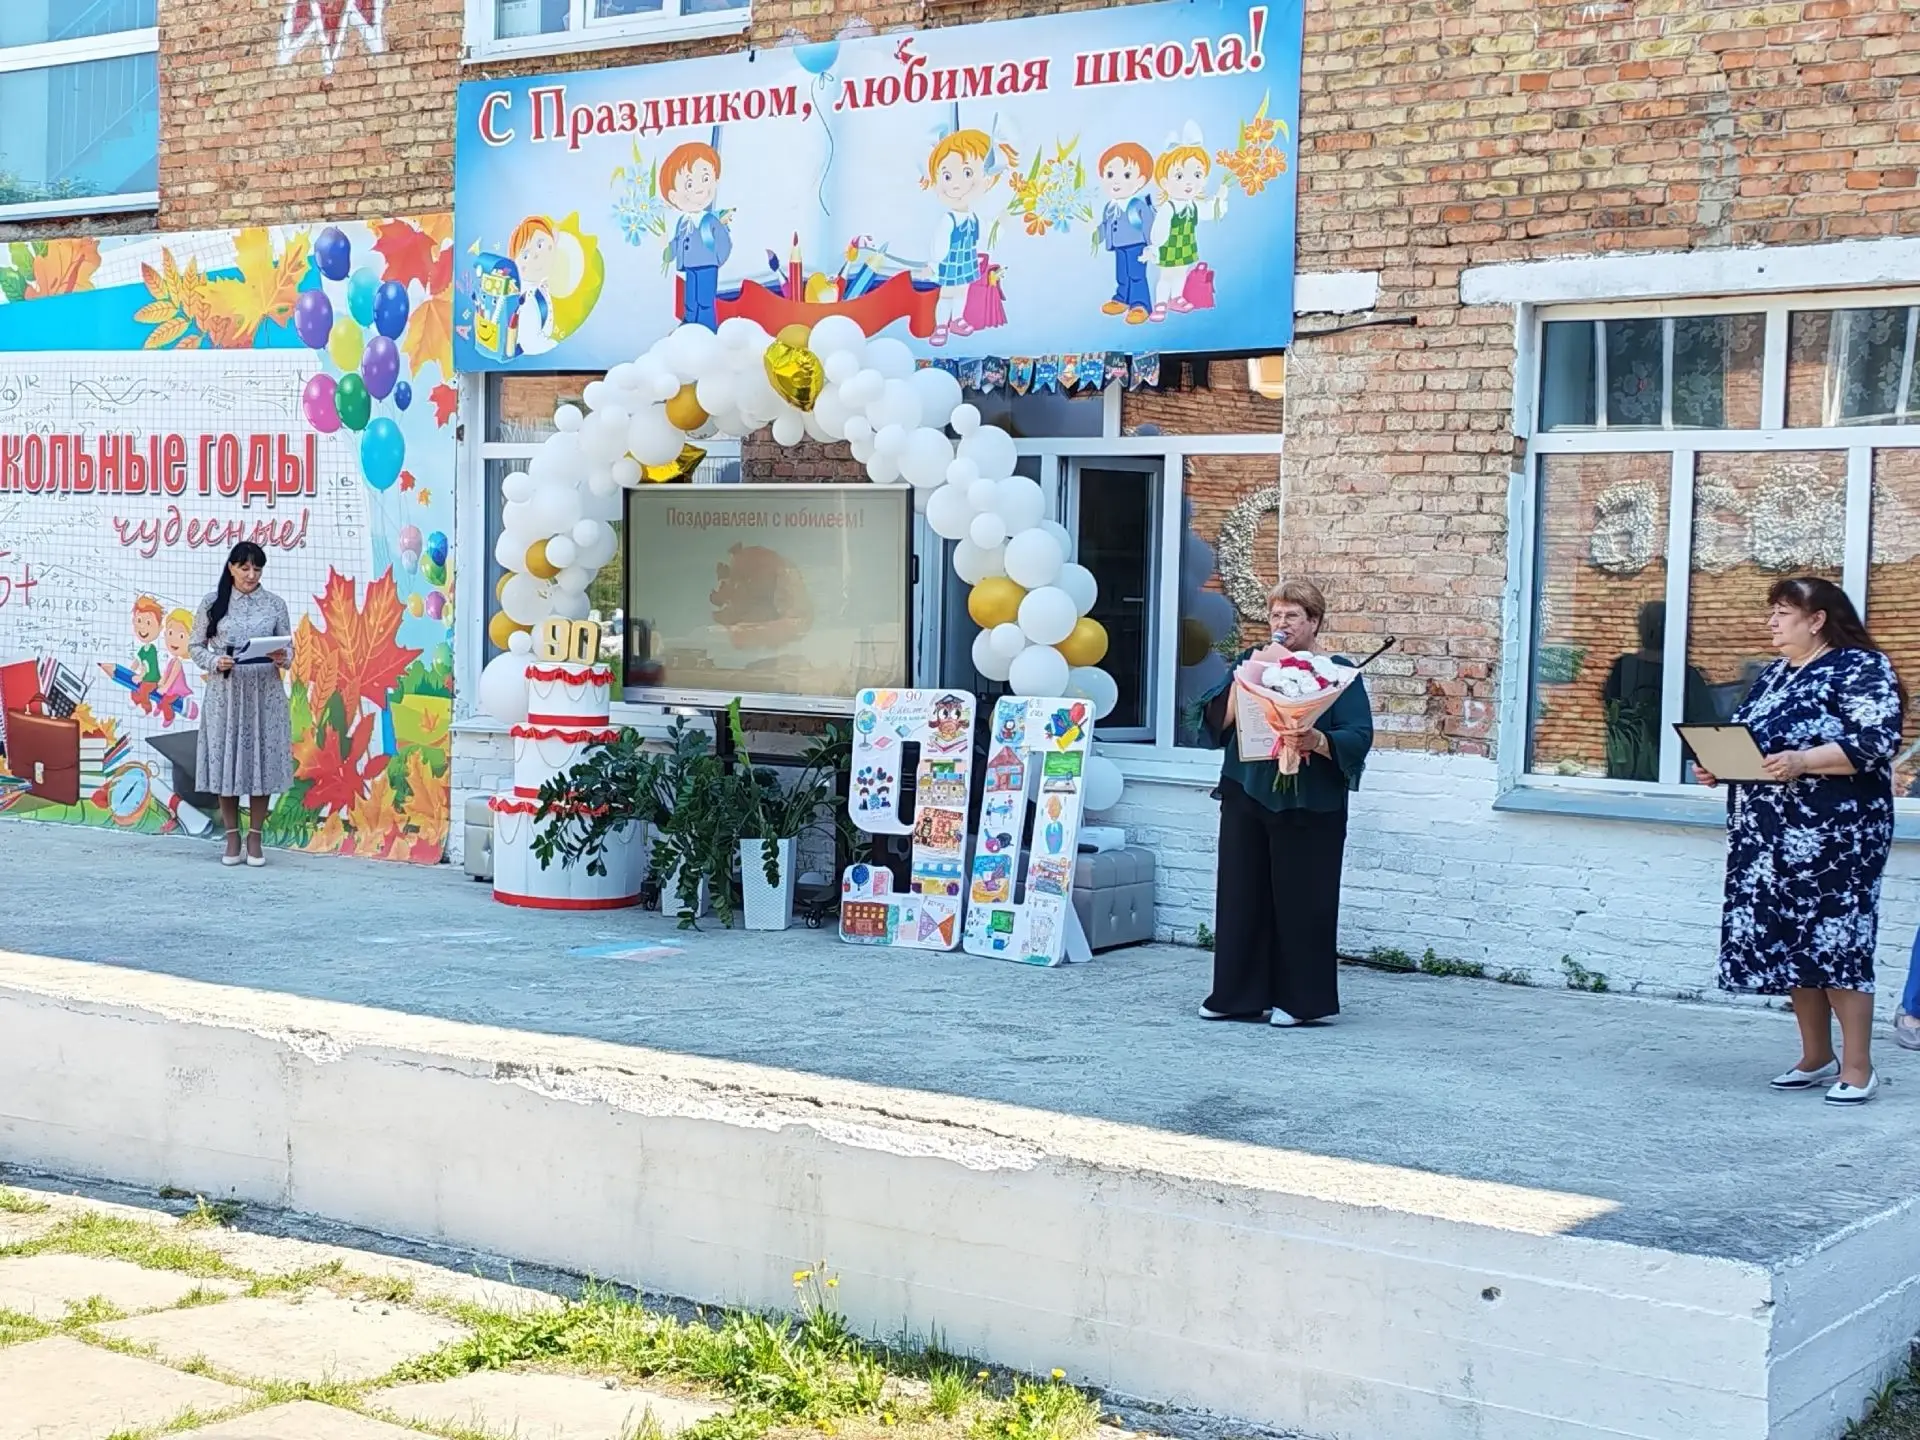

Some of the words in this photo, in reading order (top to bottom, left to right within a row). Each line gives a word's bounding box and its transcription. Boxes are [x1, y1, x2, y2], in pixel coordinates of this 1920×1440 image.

[479, 91, 515, 145] С
[529, 84, 813, 150] Праздником,
[833, 37, 1051, 112] любимая
[1073, 8, 1268, 89] школа!
[113, 504, 310, 558] чудесные!
[666, 507, 768, 531] Поздравляем
[773, 511, 781, 528] с
[785, 507, 865, 528] юбилеем!
[543, 616, 601, 666] 90
